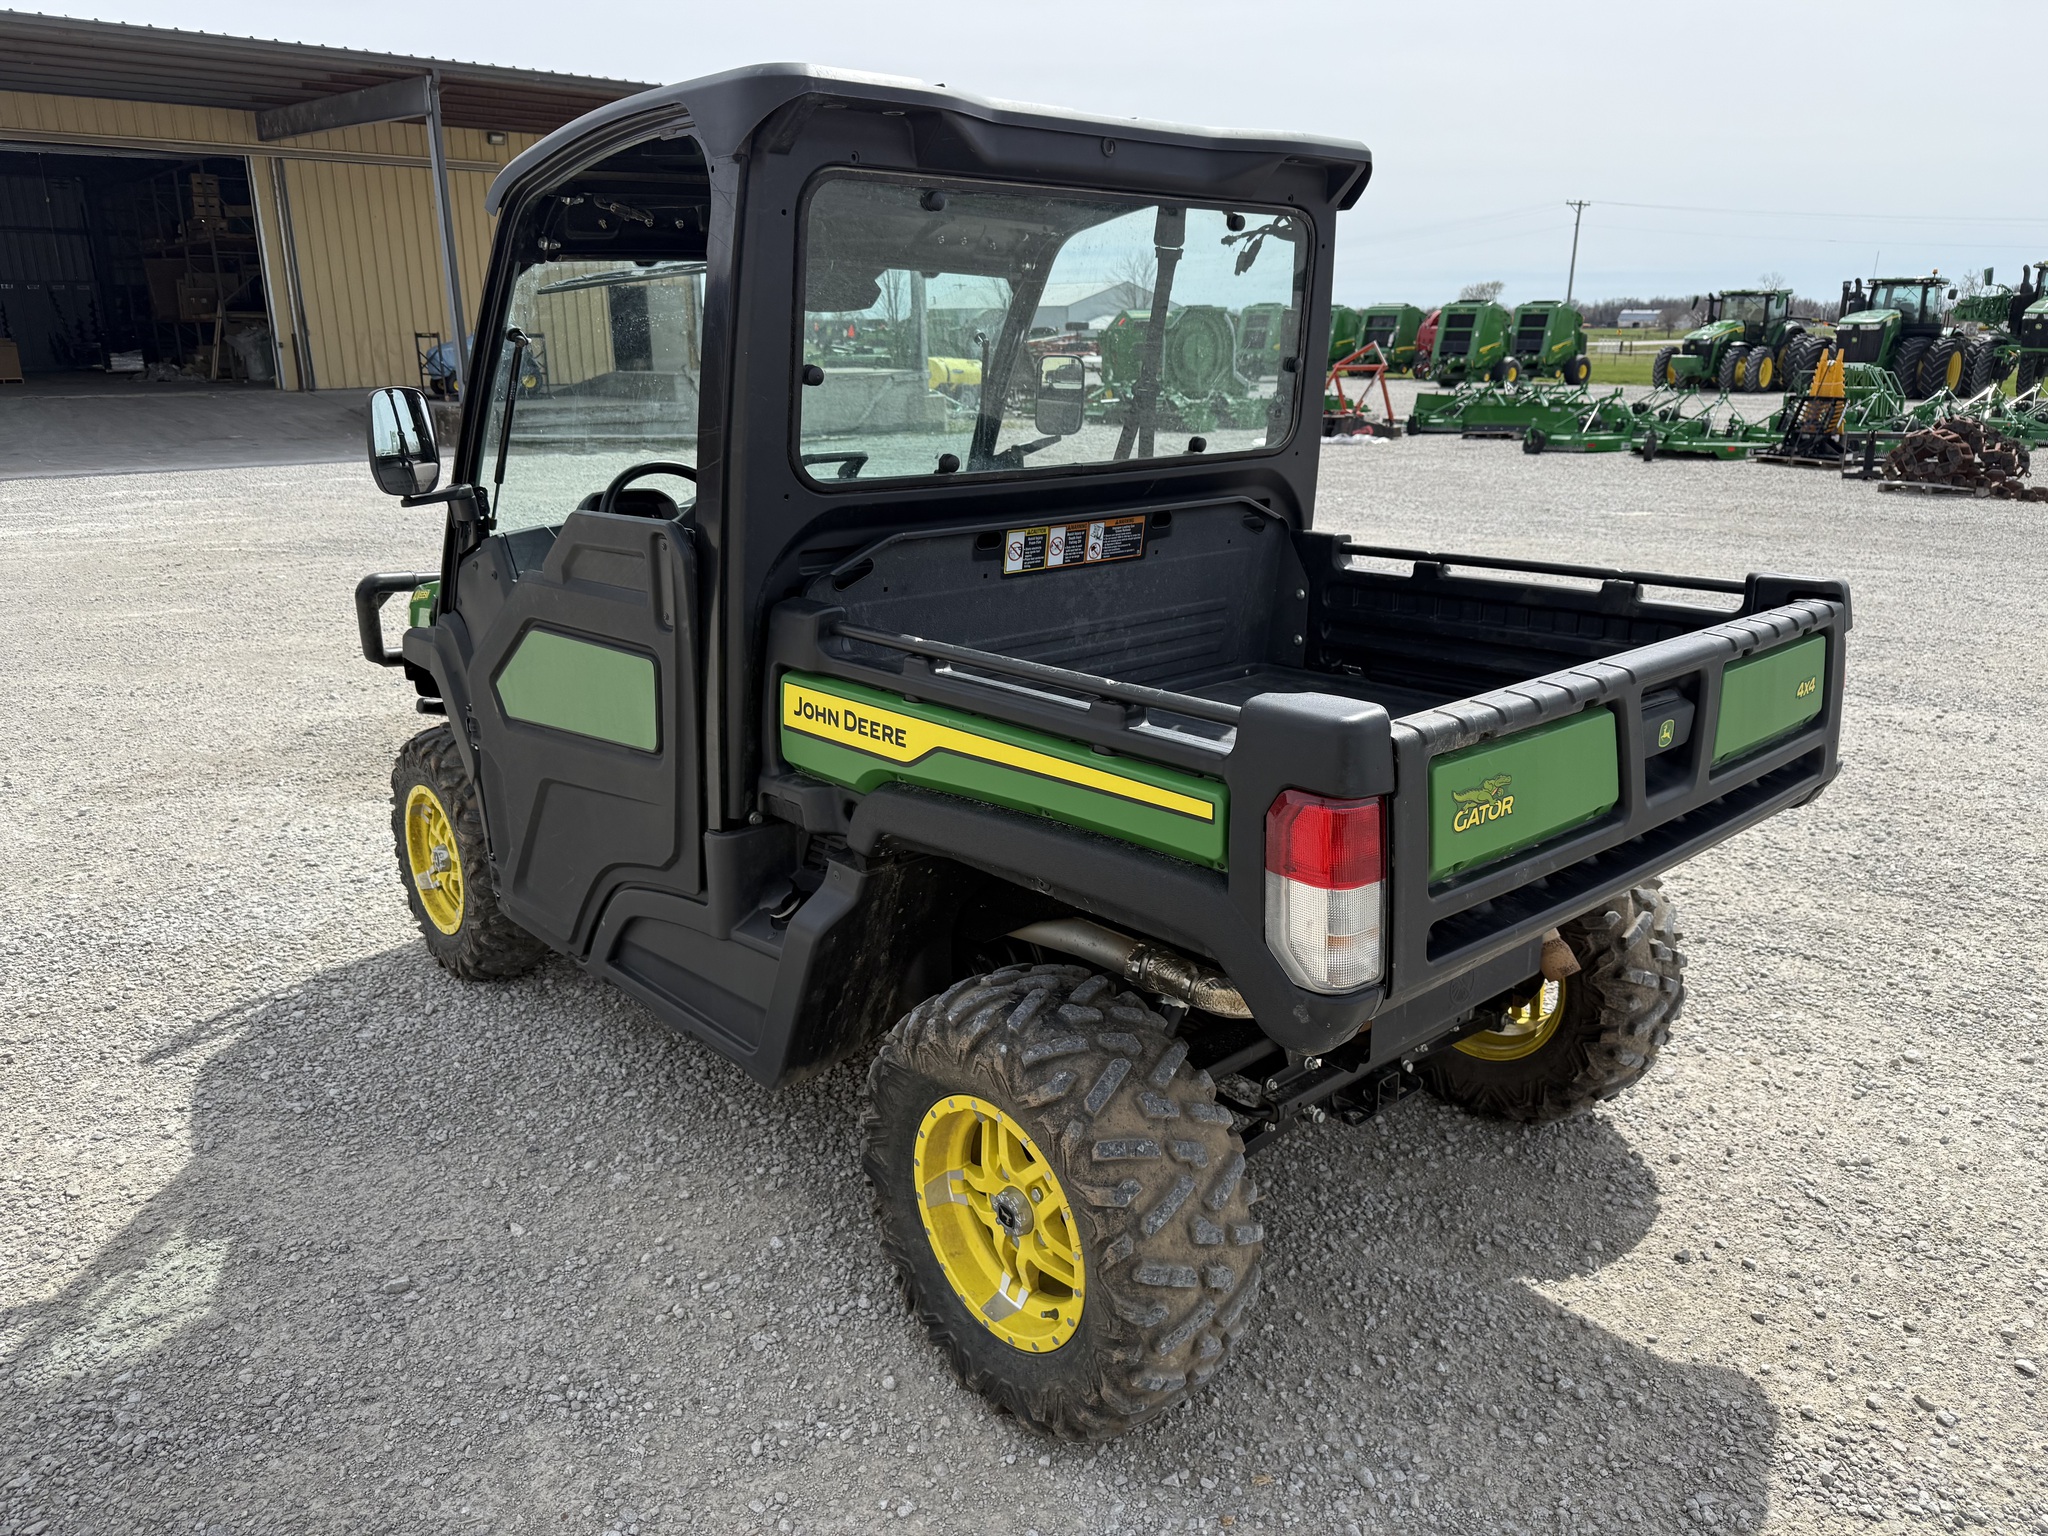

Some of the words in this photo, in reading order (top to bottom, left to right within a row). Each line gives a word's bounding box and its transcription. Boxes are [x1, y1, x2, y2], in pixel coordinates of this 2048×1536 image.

[793, 697, 839, 728] JOHN
[844, 709, 907, 748] DEERE
[1453, 795, 1515, 833] GATOR
